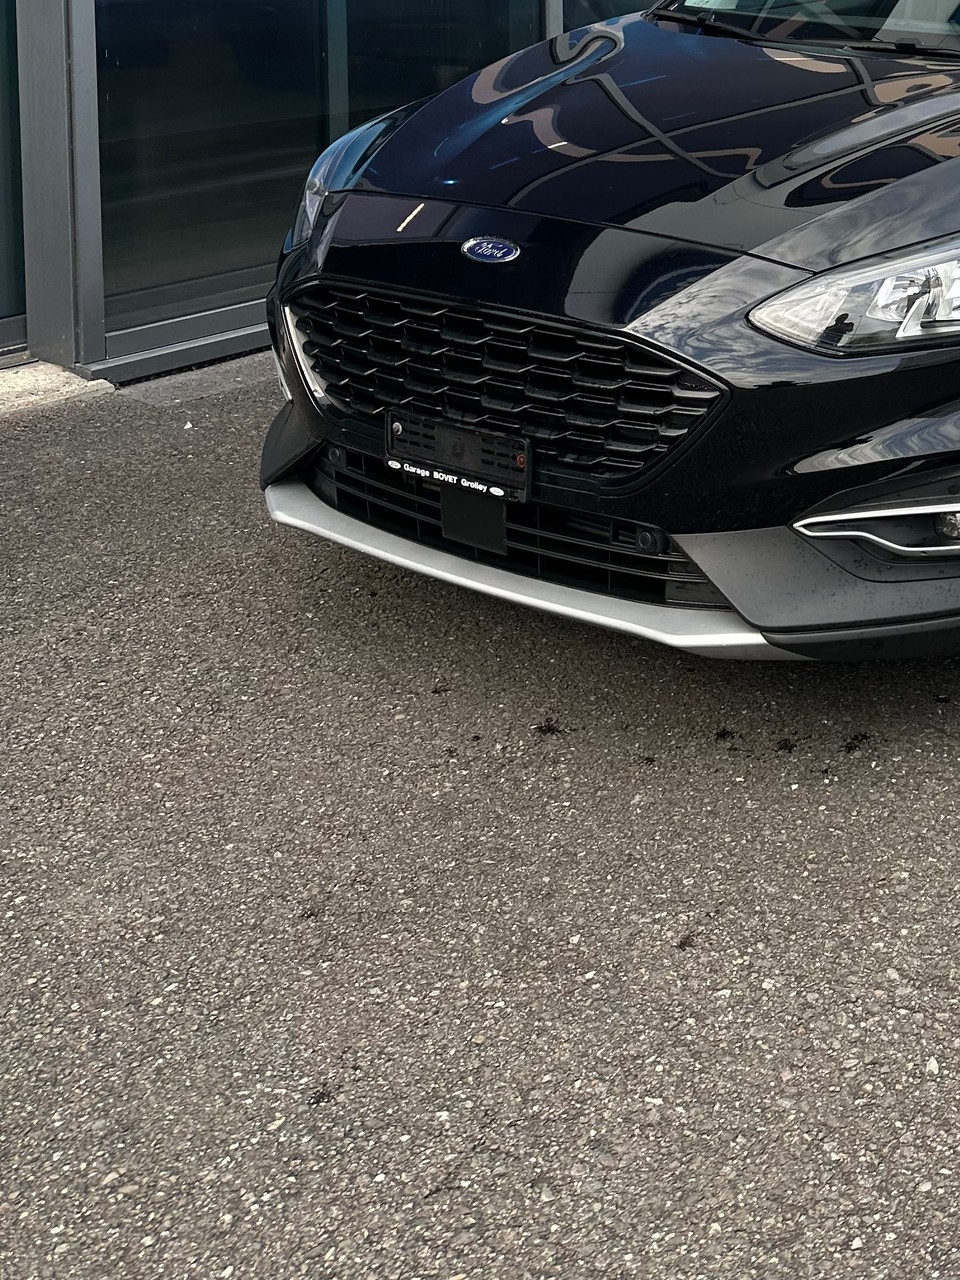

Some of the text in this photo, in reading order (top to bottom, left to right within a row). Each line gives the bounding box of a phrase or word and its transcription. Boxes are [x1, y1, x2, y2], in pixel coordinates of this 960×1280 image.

[474, 242, 508, 257] Ford
[403, 463, 430, 477] Garage
[433, 470, 458, 484] BOVET
[460, 478, 488, 493] Grolley
